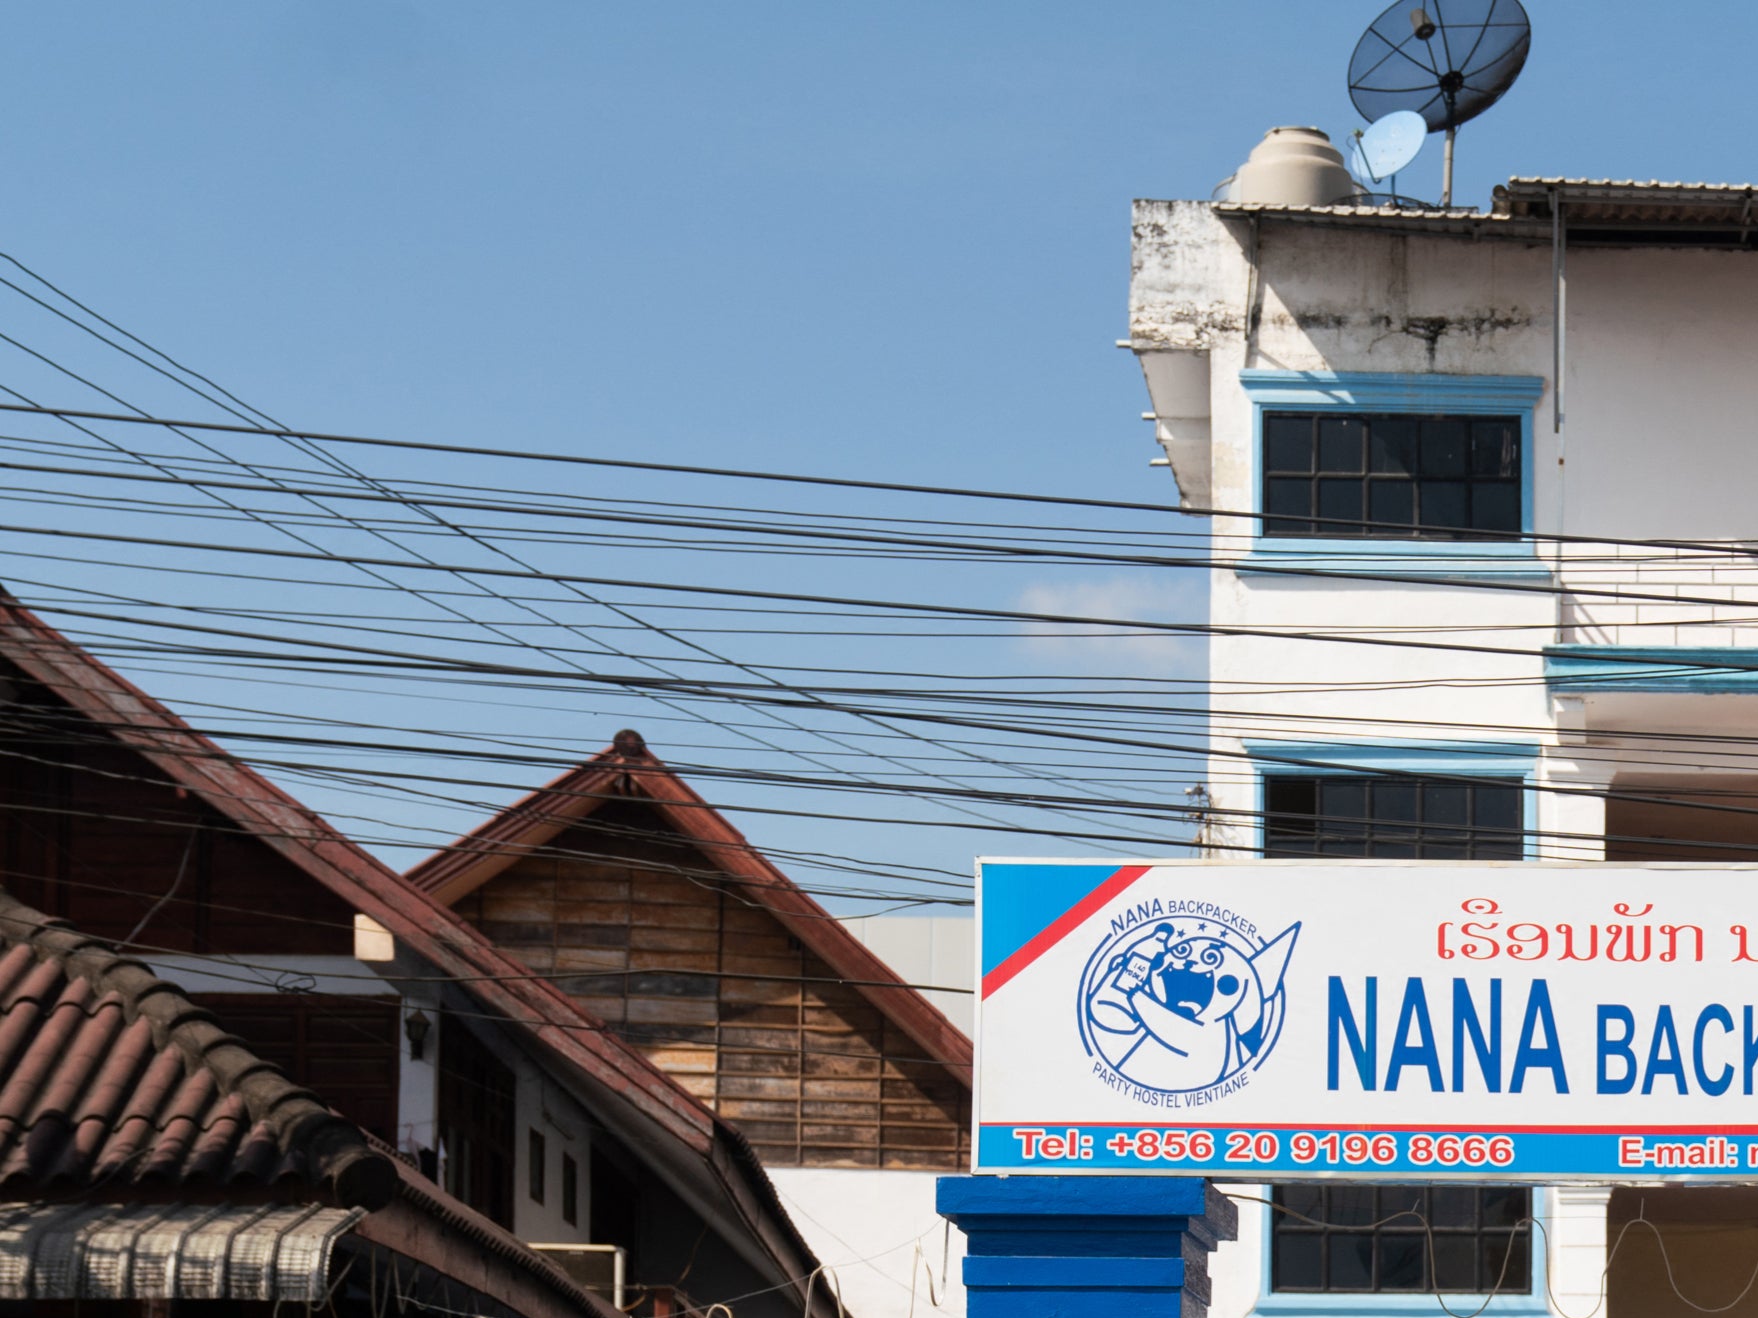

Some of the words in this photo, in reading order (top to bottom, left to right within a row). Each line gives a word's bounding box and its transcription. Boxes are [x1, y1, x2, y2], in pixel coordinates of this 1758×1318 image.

[1110, 898, 1164, 936] NANA
[1168, 900, 1258, 939] BACKPACKER
[1327, 975, 1570, 1095] NANA
[1092, 1061, 1131, 1096] PARTY
[1132, 1086, 1182, 1108] HOSTEL
[1184, 1071, 1250, 1108] VIENTIANE
[1014, 1130, 1092, 1158] Tel:
[1107, 1131, 1213, 1159] +856
[1227, 1133, 1278, 1160] 20
[1291, 1134, 1396, 1162] 9196
[1410, 1135, 1514, 1164] 8666
[1619, 1137, 1738, 1167] E-mail:
